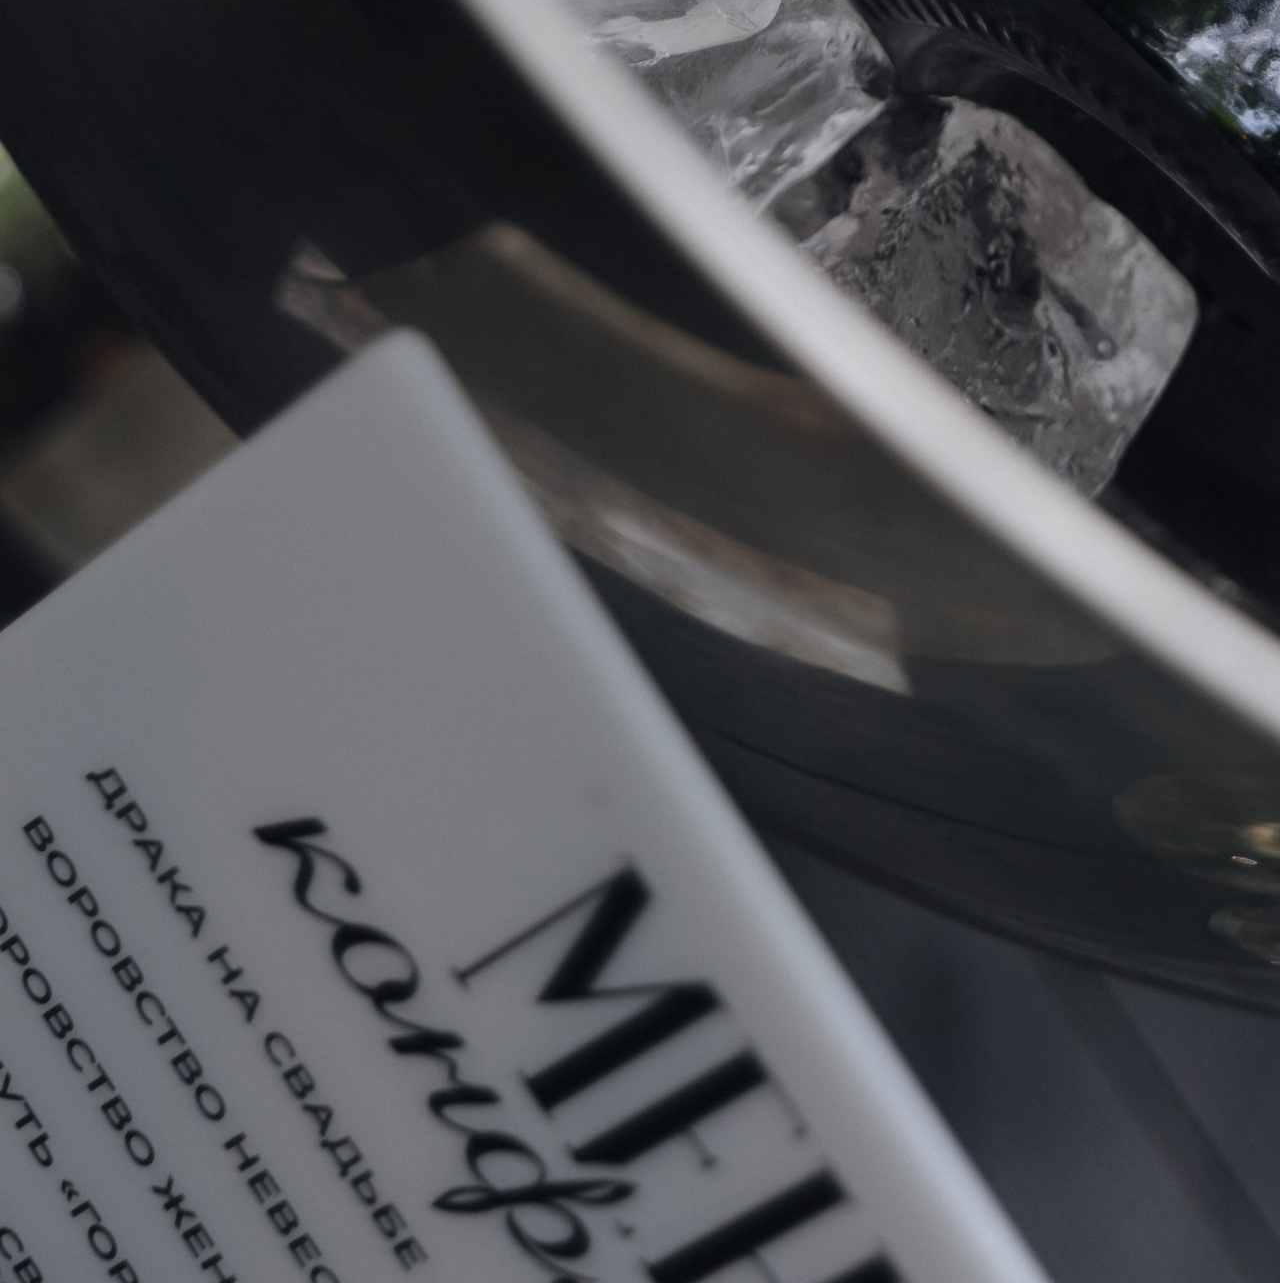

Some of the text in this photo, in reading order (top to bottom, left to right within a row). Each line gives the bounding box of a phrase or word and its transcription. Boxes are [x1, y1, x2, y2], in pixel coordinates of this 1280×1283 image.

[0, 904, 156, 1169] РОВСТВО
[22, 814, 228, 1123] ВОРОВСТВО
[85, 766, 430, 1273] ДРАКА НА СВАДЬБЕ
